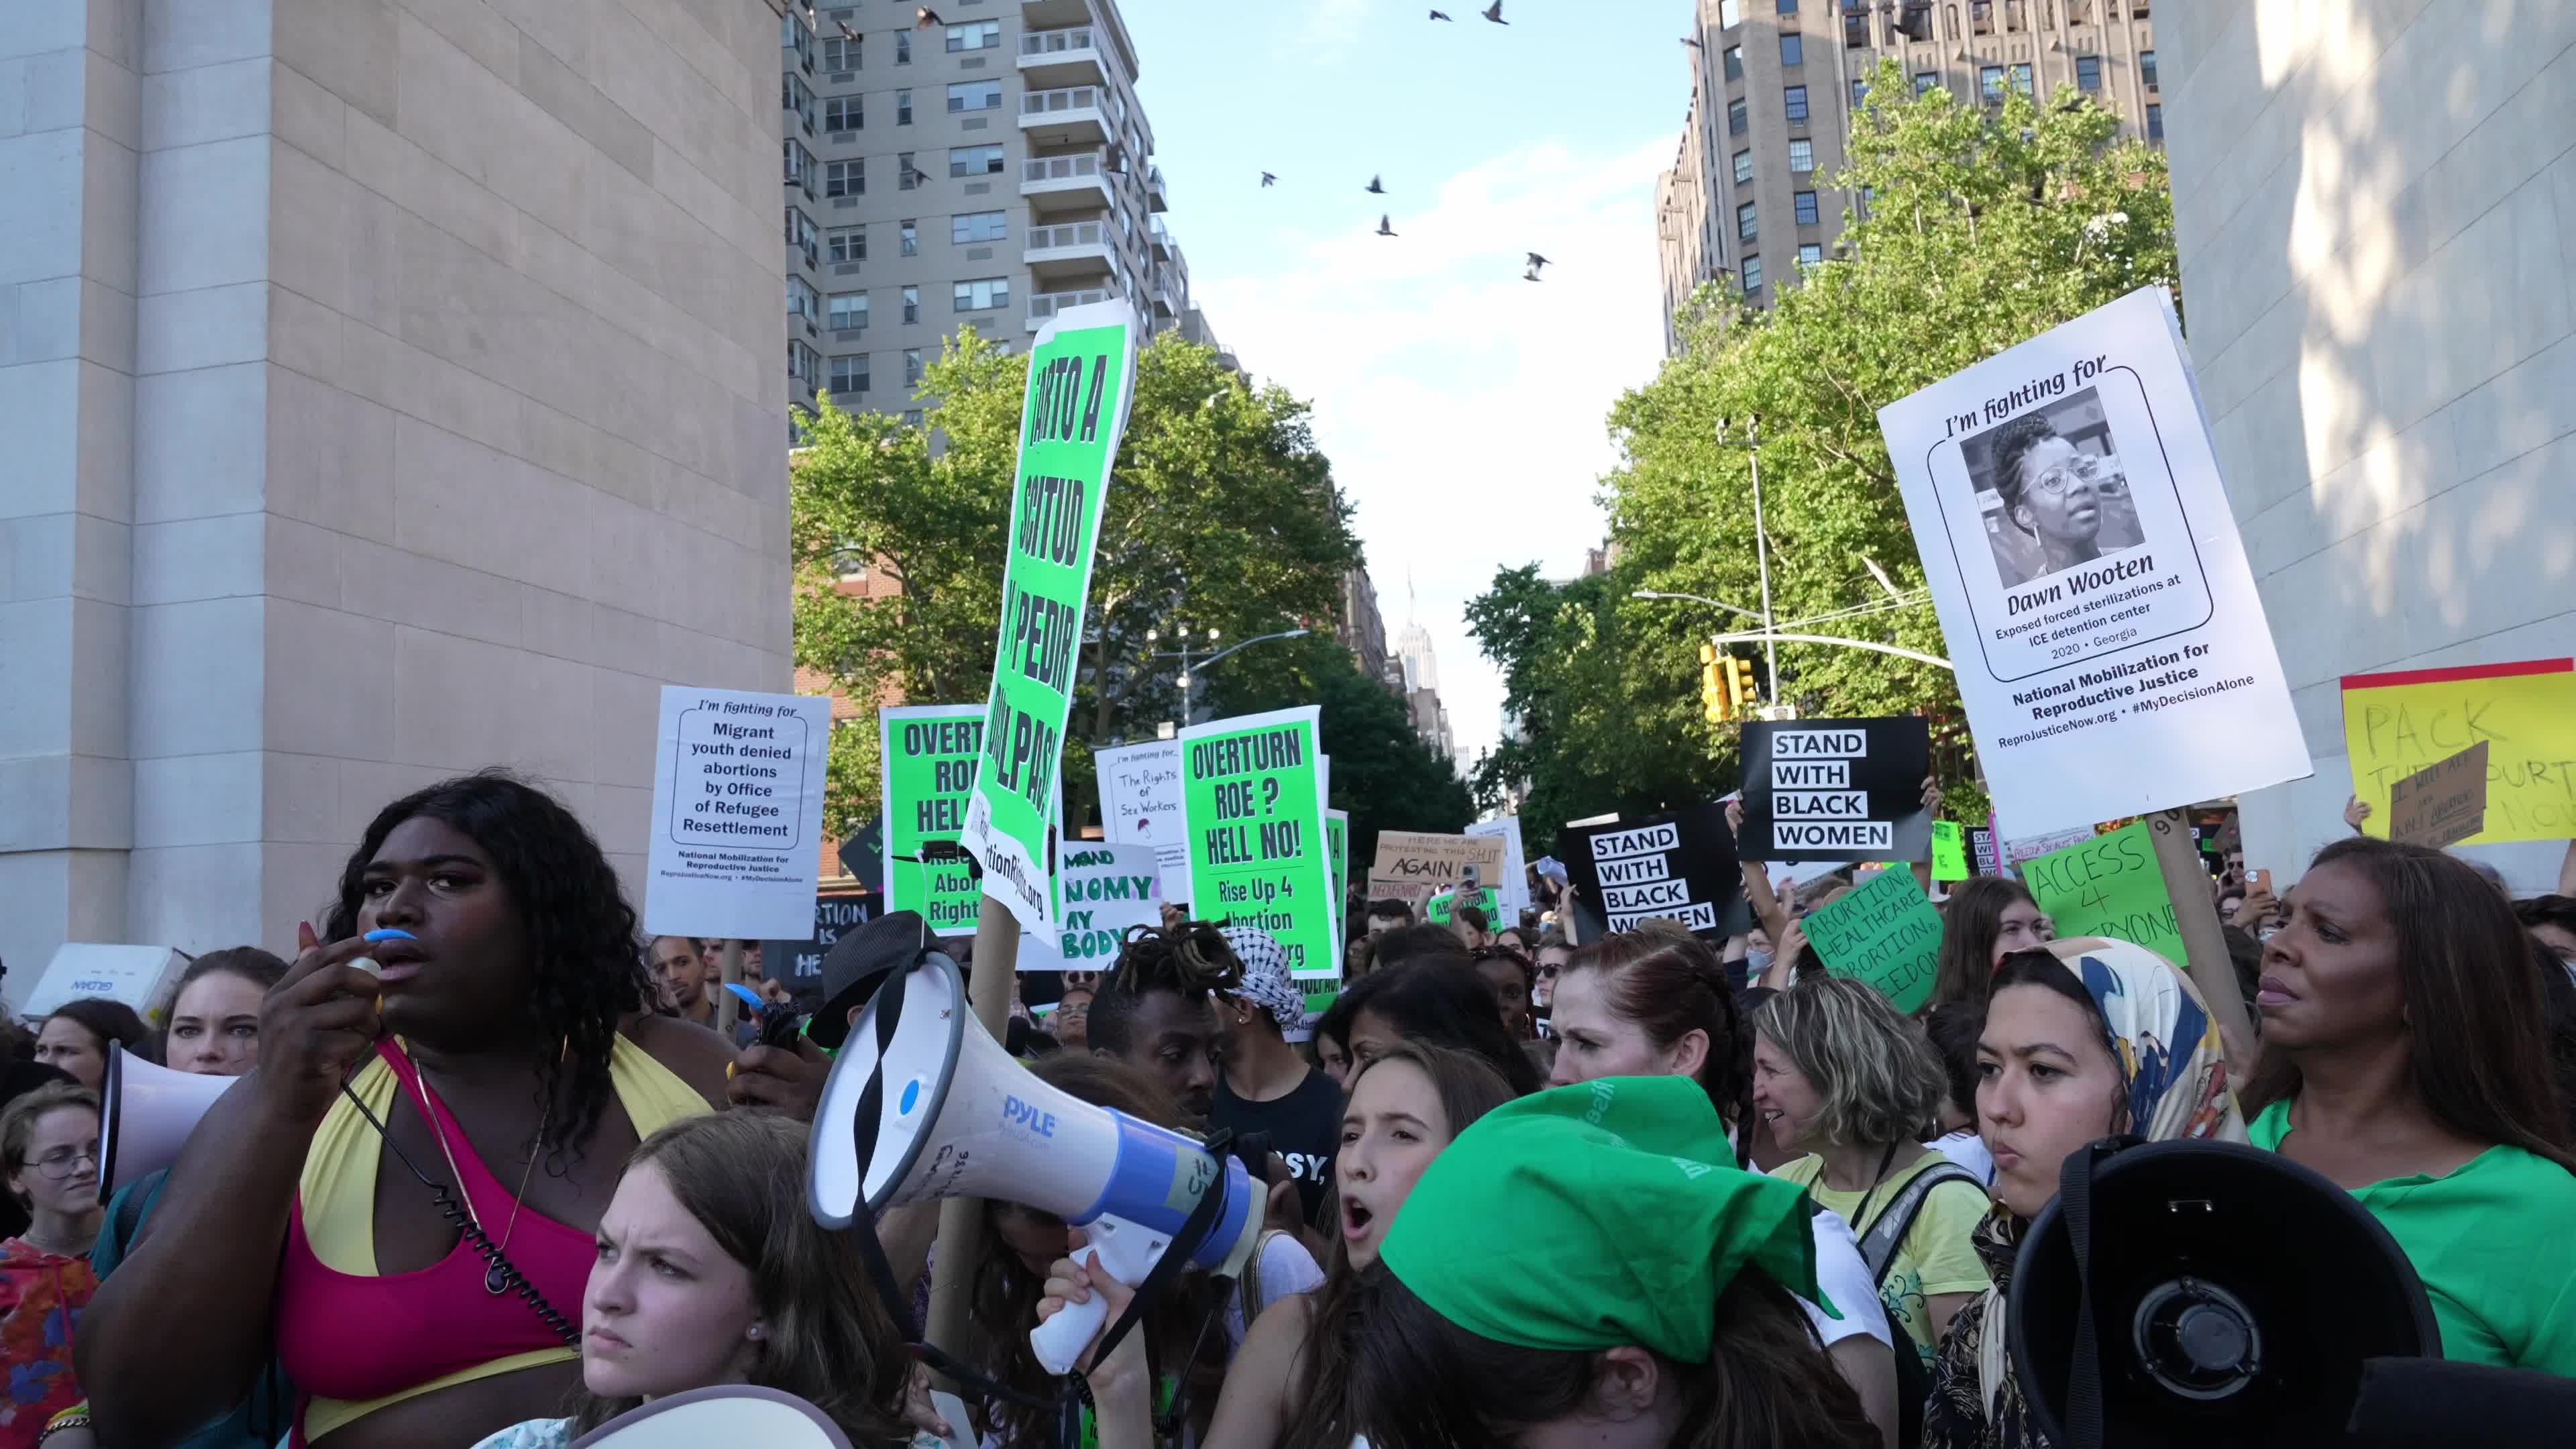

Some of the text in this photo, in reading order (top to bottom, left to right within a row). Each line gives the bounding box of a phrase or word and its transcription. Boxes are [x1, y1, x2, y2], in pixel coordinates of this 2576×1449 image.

[1080, 355, 1107, 442] A
[1945, 354, 2108, 438] I'm fighting for
[2007, 554, 2155, 616] Dawn Wooten
[1995, 574, 2181, 641] Exposed forced sterilizations at
[2029, 602, 2151, 648] ICE detention center
[1012, 592, 1075, 696] PEDIR
[2051, 627, 2138, 660] 2020 Georgia
[2012, 643, 2210, 707] National Mobilization for
[2031, 665, 2199, 720] Reproductive Justice
[698, 699, 797, 718] I'm fighting for
[1998, 674, 2255, 749] ReproJusticeNow.org #MyDecisionAlone
[713, 722, 775, 739] Migrant
[905, 721, 986, 757] OVERT
[2363, 696, 2511, 759] PACK
[692, 743, 792, 759] youth denied
[1193, 729, 1302, 780] OVERTURN
[1776, 734, 1862, 754] STAND
[703, 762, 777, 778] abortions
[1118, 769, 1177, 787] The Rights
[1776, 765, 1844, 784] WITH
[706, 782, 772, 797] by Office
[1139, 786, 1151, 797] of
[1214, 776, 1279, 820] ROE ?
[695, 800, 779, 818] of Refugee
[1140, 800, 1177, 813] Workers
[1776, 796, 1862, 814] BLACK
[683, 818, 788, 837] Resettlement
[1778, 826, 1887, 845] WOMEN
[1205, 824, 1253, 865] HELL
[1260, 820, 1303, 859] NO!
[1595, 828, 1674, 856] STAND
[1977, 845, 1992, 854] WI
[678, 851, 789, 863] National Mobilization for
[686, 861, 780, 873] Reproductive Justice
[1390, 858, 1460, 879] AGAIN!
[2034, 835, 2146, 902] ACCESS
[934, 873, 978, 894] Abor
[1600, 859, 1664, 882] WITH
[1219, 875, 1293, 905] Rise Up 4
[1606, 883, 1684, 908] BLACK
[2081, 885, 2110, 915] 4
[930, 900, 979, 924] Right
[1808, 871, 1904, 941] ABORTION
[819, 928, 837, 945] IS
[1818, 888, 1925, 965] HEALTHCARE
[1061, 927, 1128, 959] BODY
[1004, 1094, 1056, 1138] PYLE
